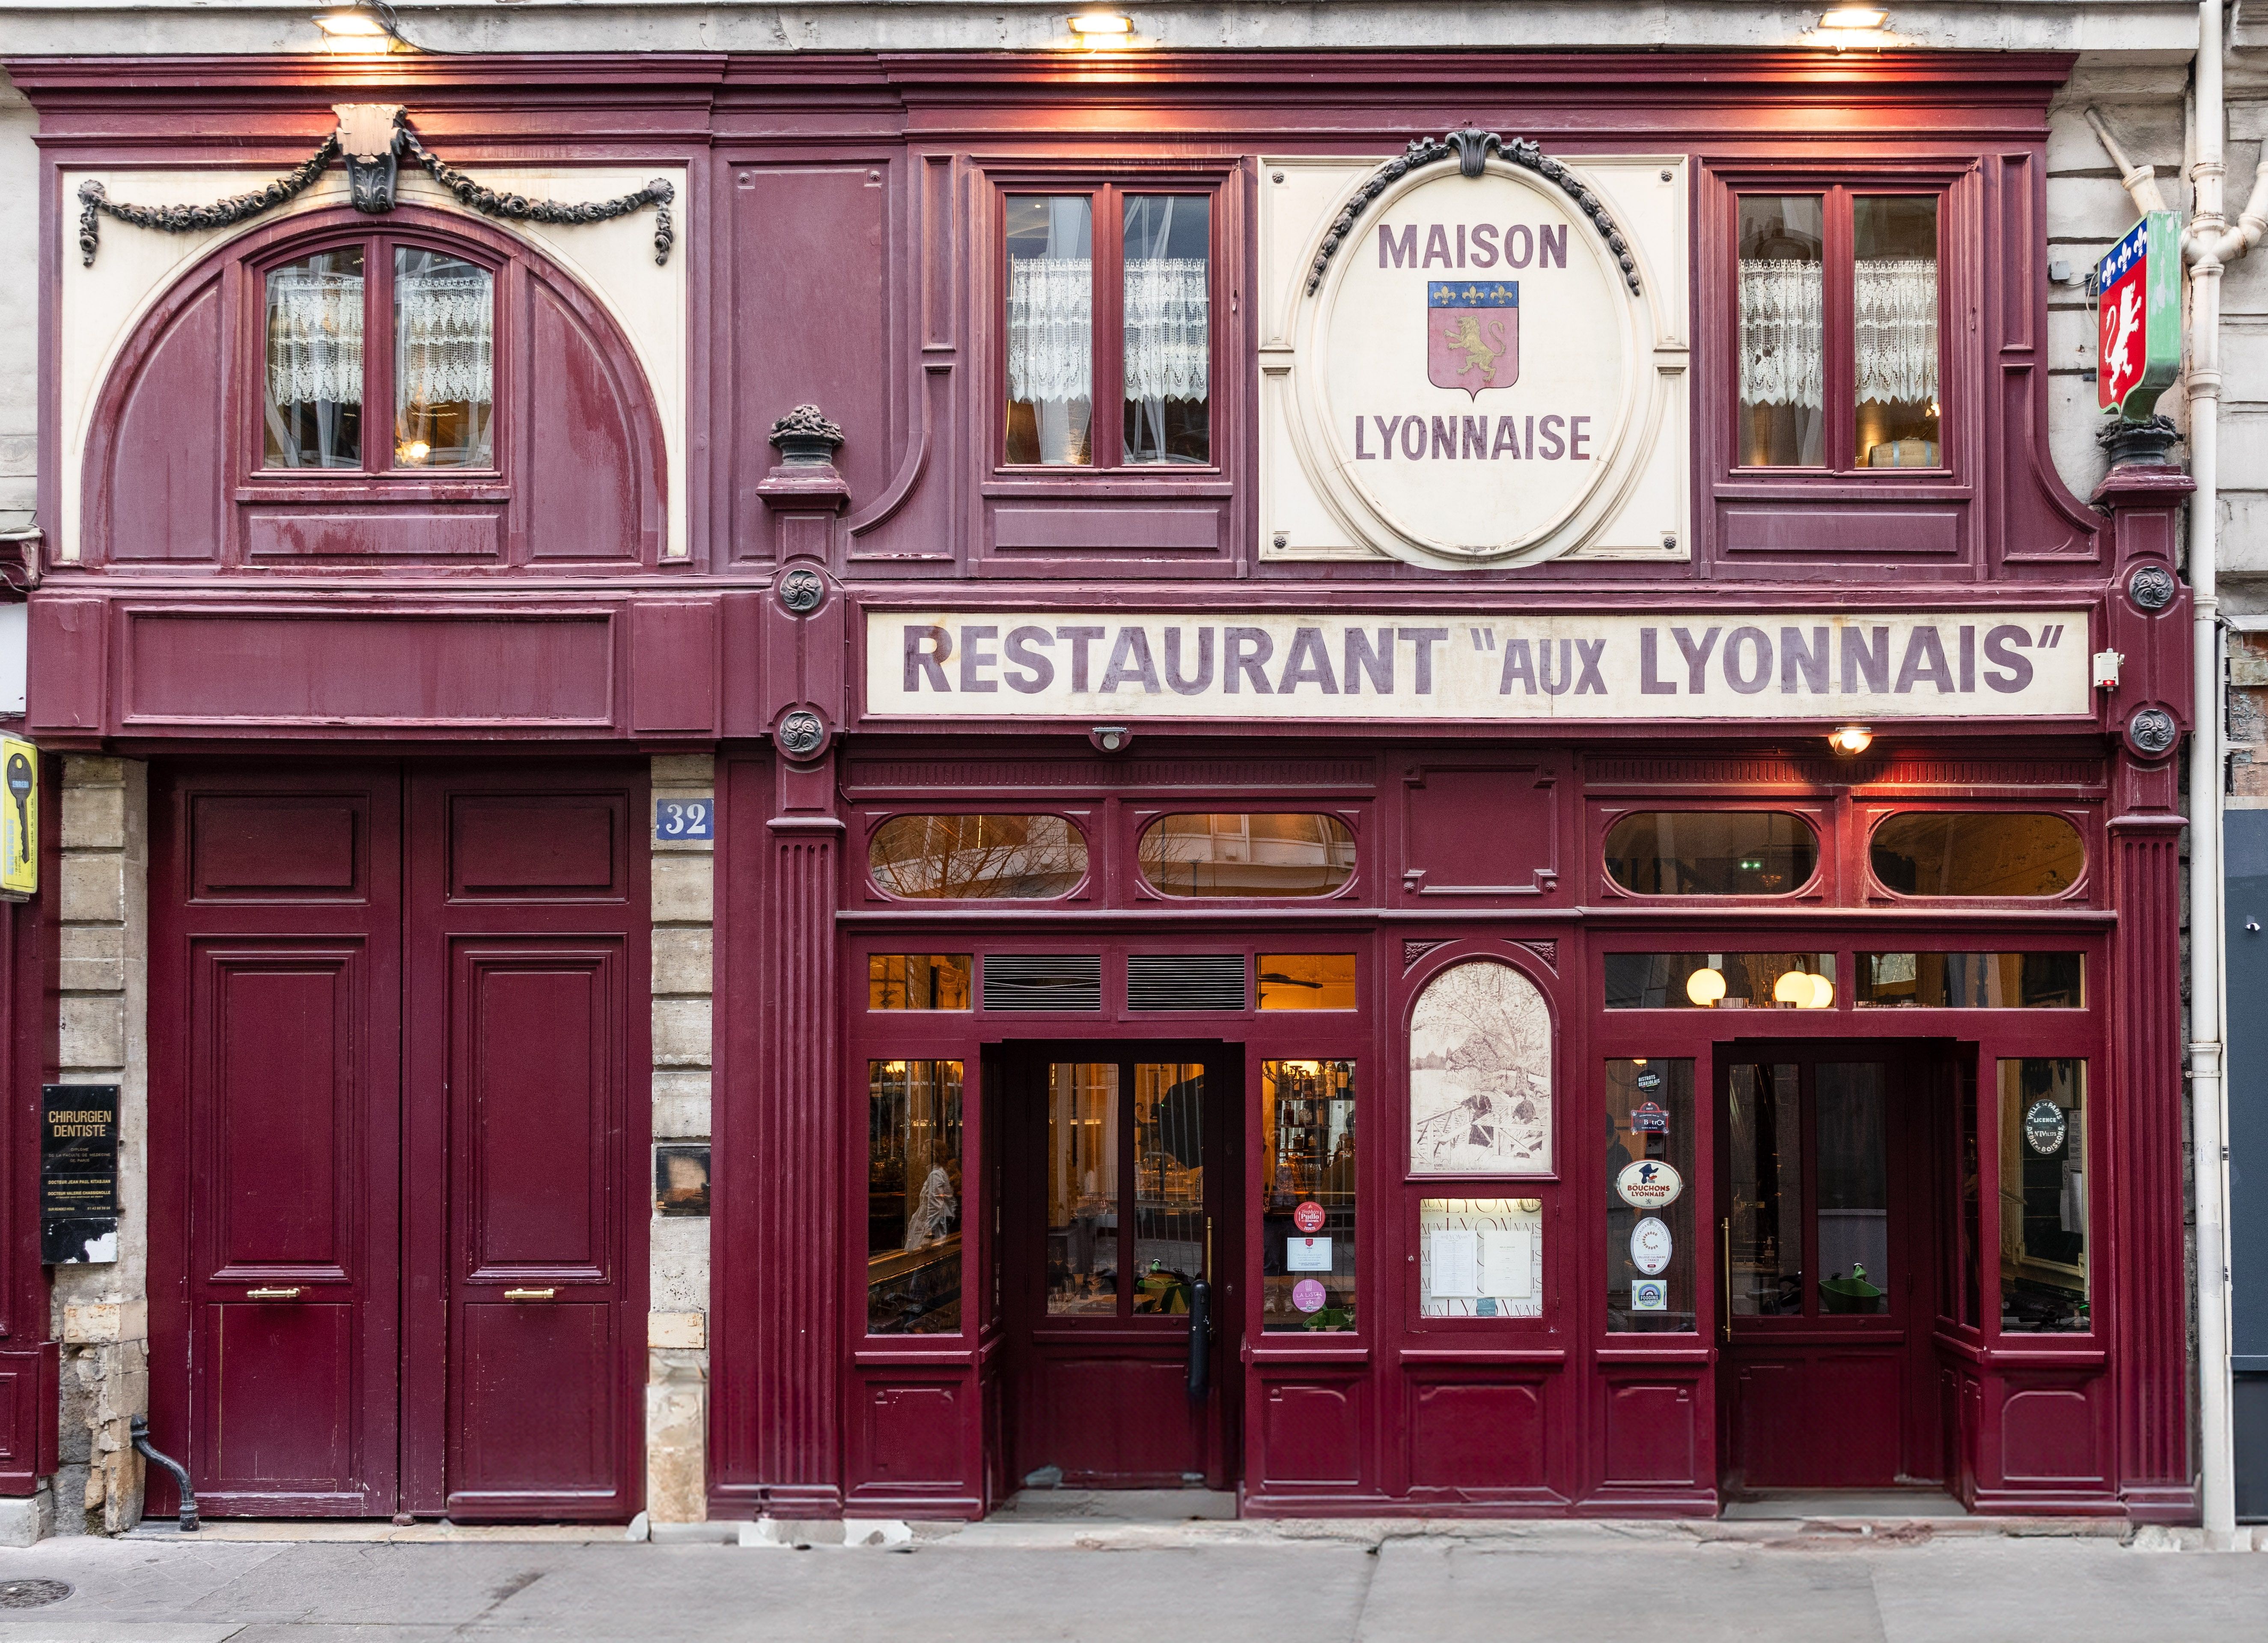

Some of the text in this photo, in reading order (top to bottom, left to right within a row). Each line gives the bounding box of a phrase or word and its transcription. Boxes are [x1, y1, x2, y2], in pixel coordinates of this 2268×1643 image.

[1378, 223, 1567, 269] MAISON
[1355, 414, 1591, 461] LYONNAISE
[903, 625, 1449, 696] RESTAURANT
[666, 804, 705, 834] 32
[1638, 1079, 1660, 1087] BEAUJOLAIS
[49, 1110, 111, 1122] CHIRURGIEN
[2028, 1103, 2041, 1119] VILLE
[2048, 1102, 2062, 1119] PARIS
[54, 1125, 106, 1137] DENTISTE
[2041, 1125, 2064, 1152] BOISSONS
[1636, 1223, 1651, 1241] RESTAURANT
